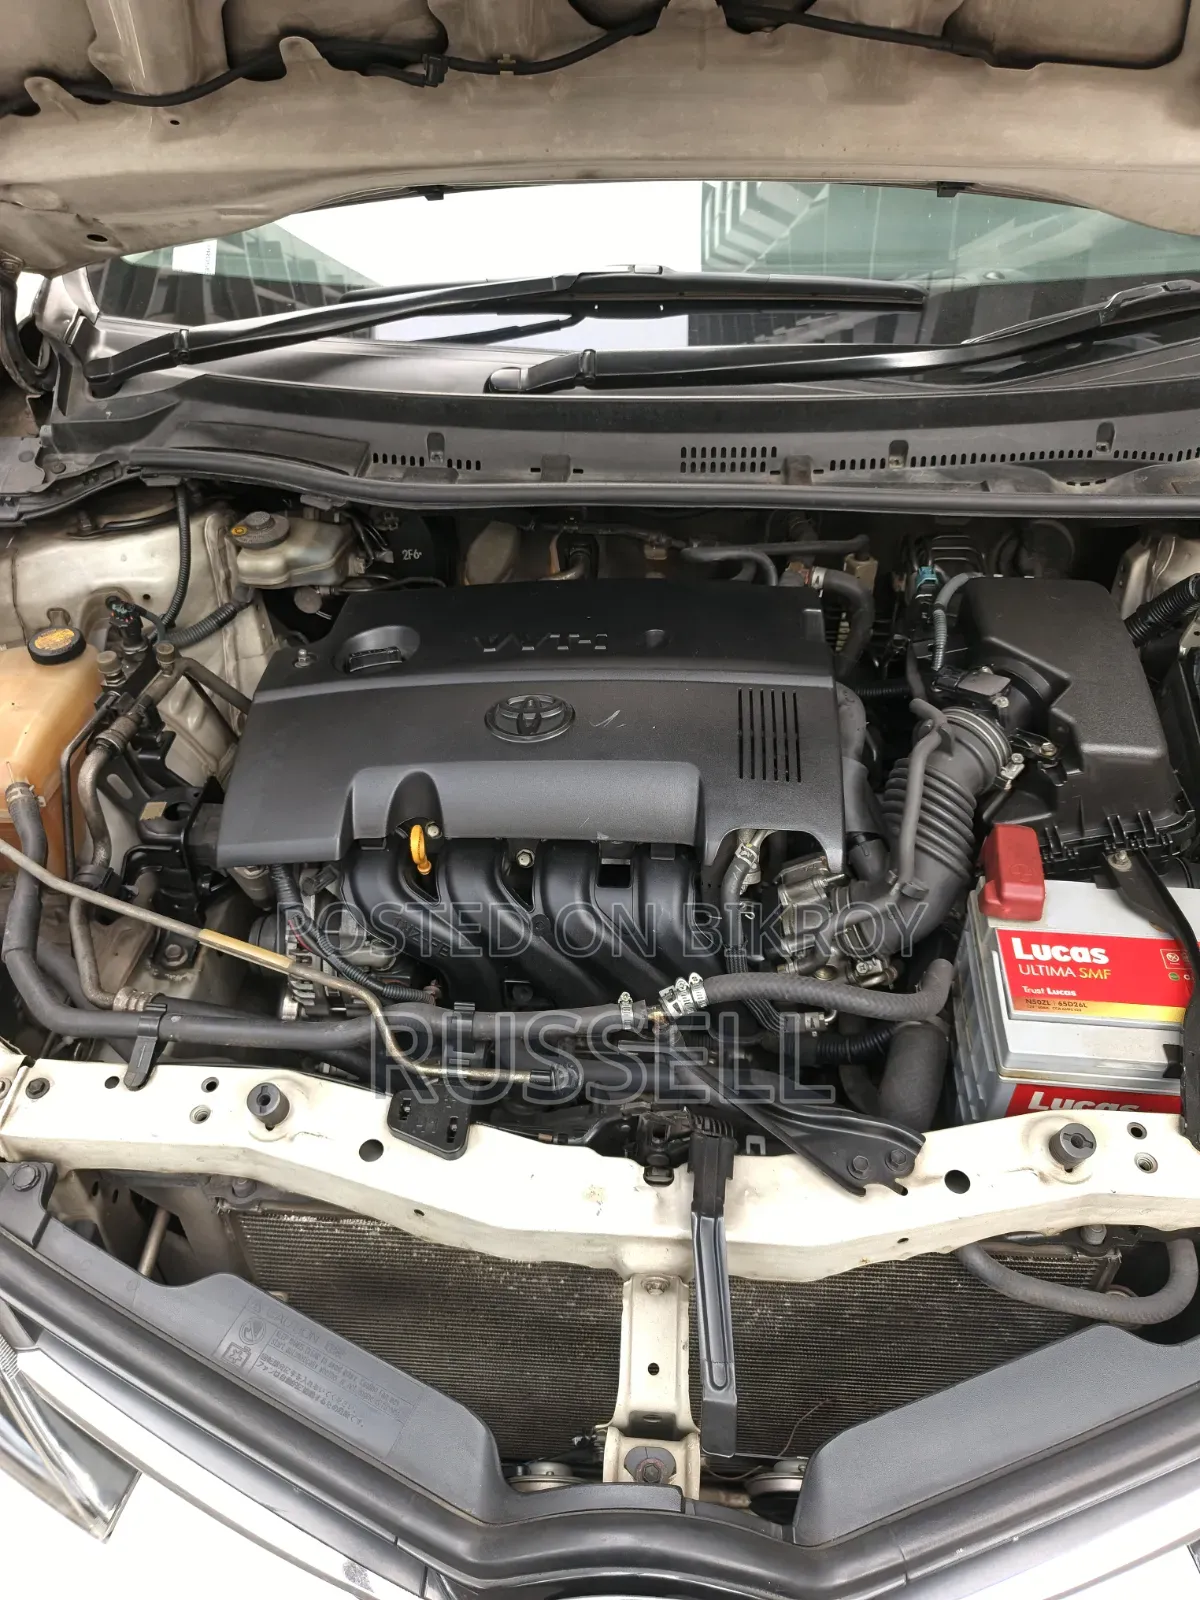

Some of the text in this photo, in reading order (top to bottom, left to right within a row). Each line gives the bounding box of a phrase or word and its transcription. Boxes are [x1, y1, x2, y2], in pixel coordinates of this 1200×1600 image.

[1011, 937, 1109, 965] Lucas
[1018, 964, 1112, 980] ULTIMA SMF
[1022, 986, 1077, 997] Trust Lucas
[266, 1306, 320, 1345] CAUTION
